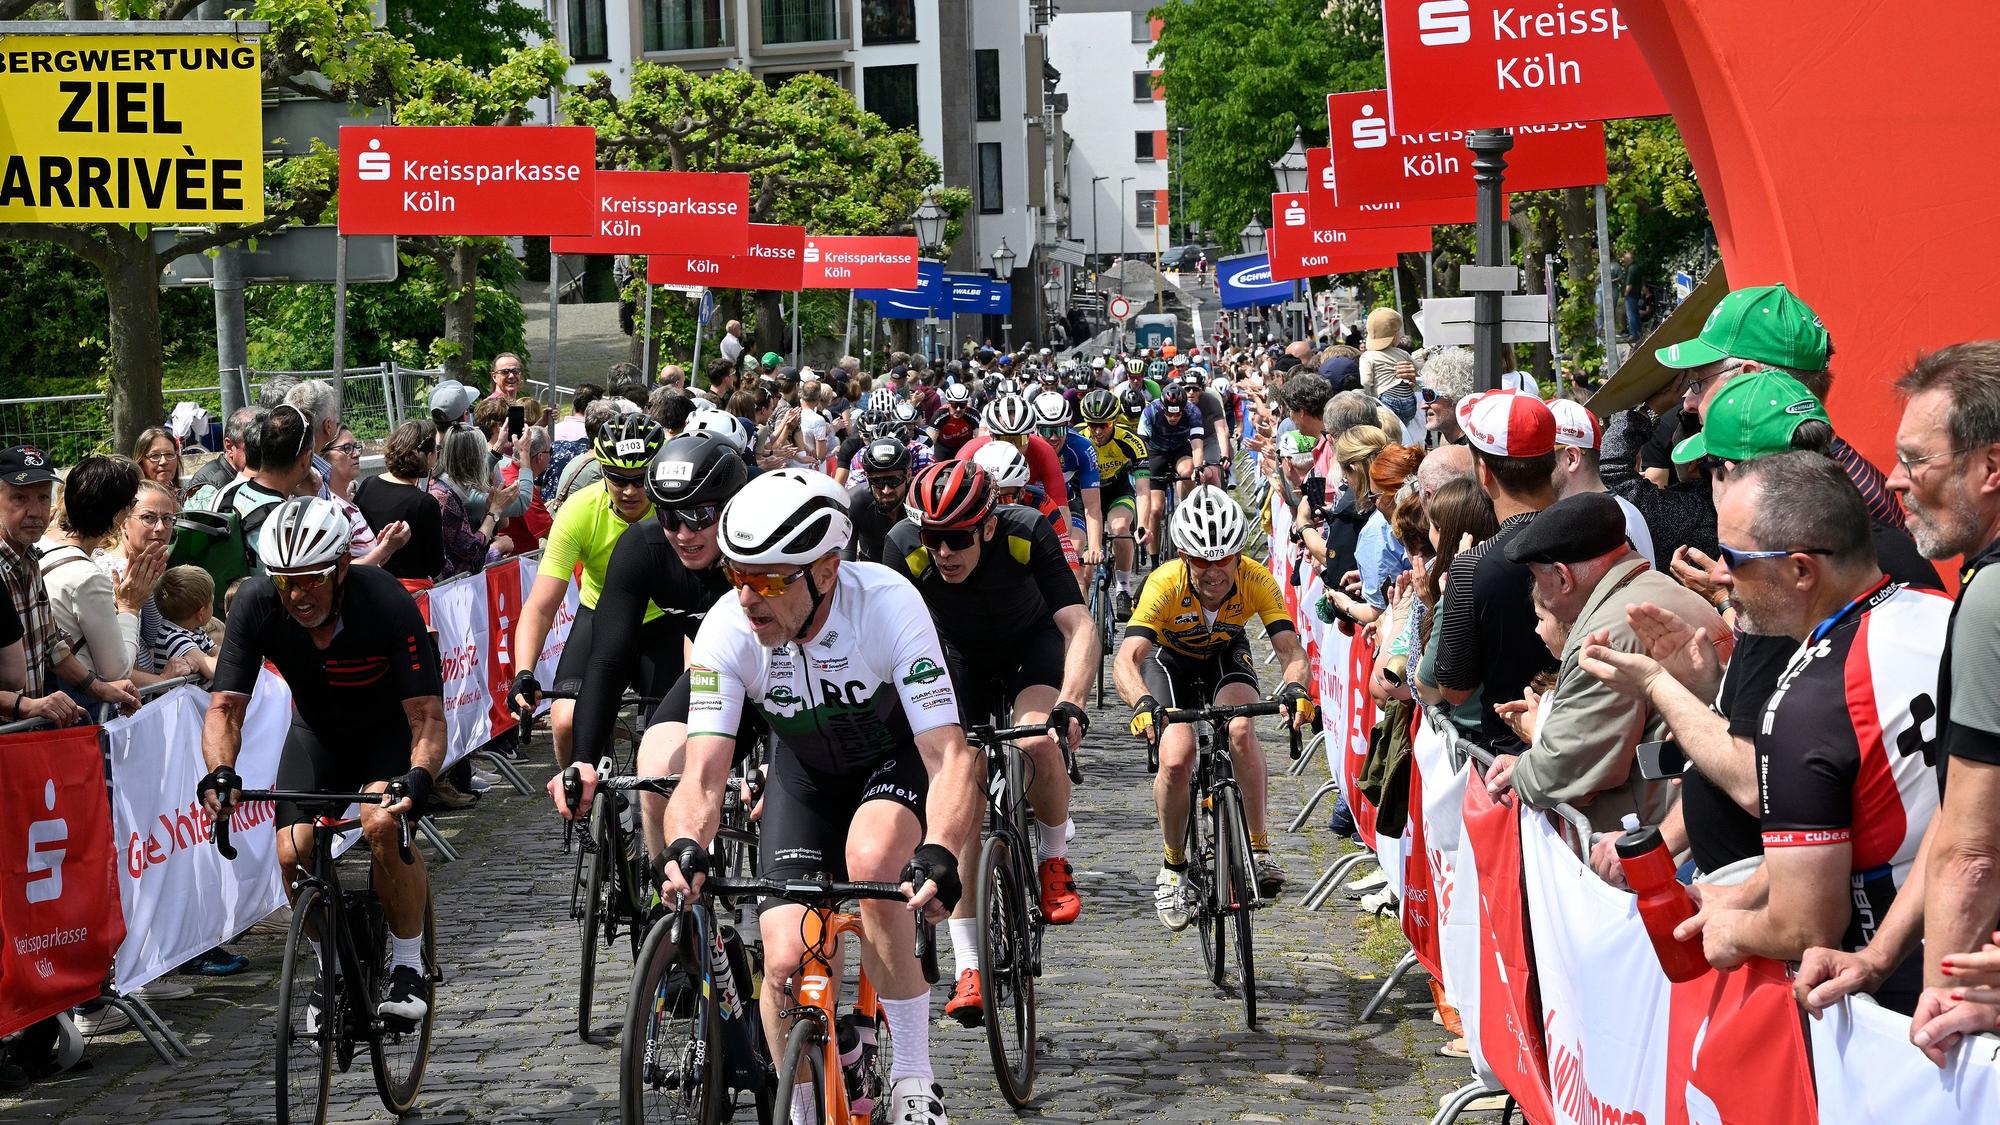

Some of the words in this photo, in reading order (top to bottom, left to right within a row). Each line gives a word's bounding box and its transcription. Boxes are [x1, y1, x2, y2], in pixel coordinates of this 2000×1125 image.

[1496, 53, 1581, 90] Köln
[58, 81, 182, 134] ZIEL
[403, 159, 580, 184] Kreissparkasse
[1403, 153, 1459, 177] Köln
[0, 145, 244, 210] ARRIVÈE
[403, 190, 455, 212] Köln
[601, 197, 738, 216] Kreissparkasse
[601, 219, 642, 237] Köln
[1313, 231, 1347, 244] Köln
[687, 259, 719, 274] Köln
[824, 251, 911, 265] Kreissparkasse
[824, 266, 851, 278] Köln
[620, 441, 641, 452] 2103
[661, 465, 687, 476] 1741
[1203, 548, 1225, 558] 5079
[820, 679, 872, 710] RC
[1760, 754, 1771, 815] Zillertal.at
[895, 788, 918, 805] e.V.
